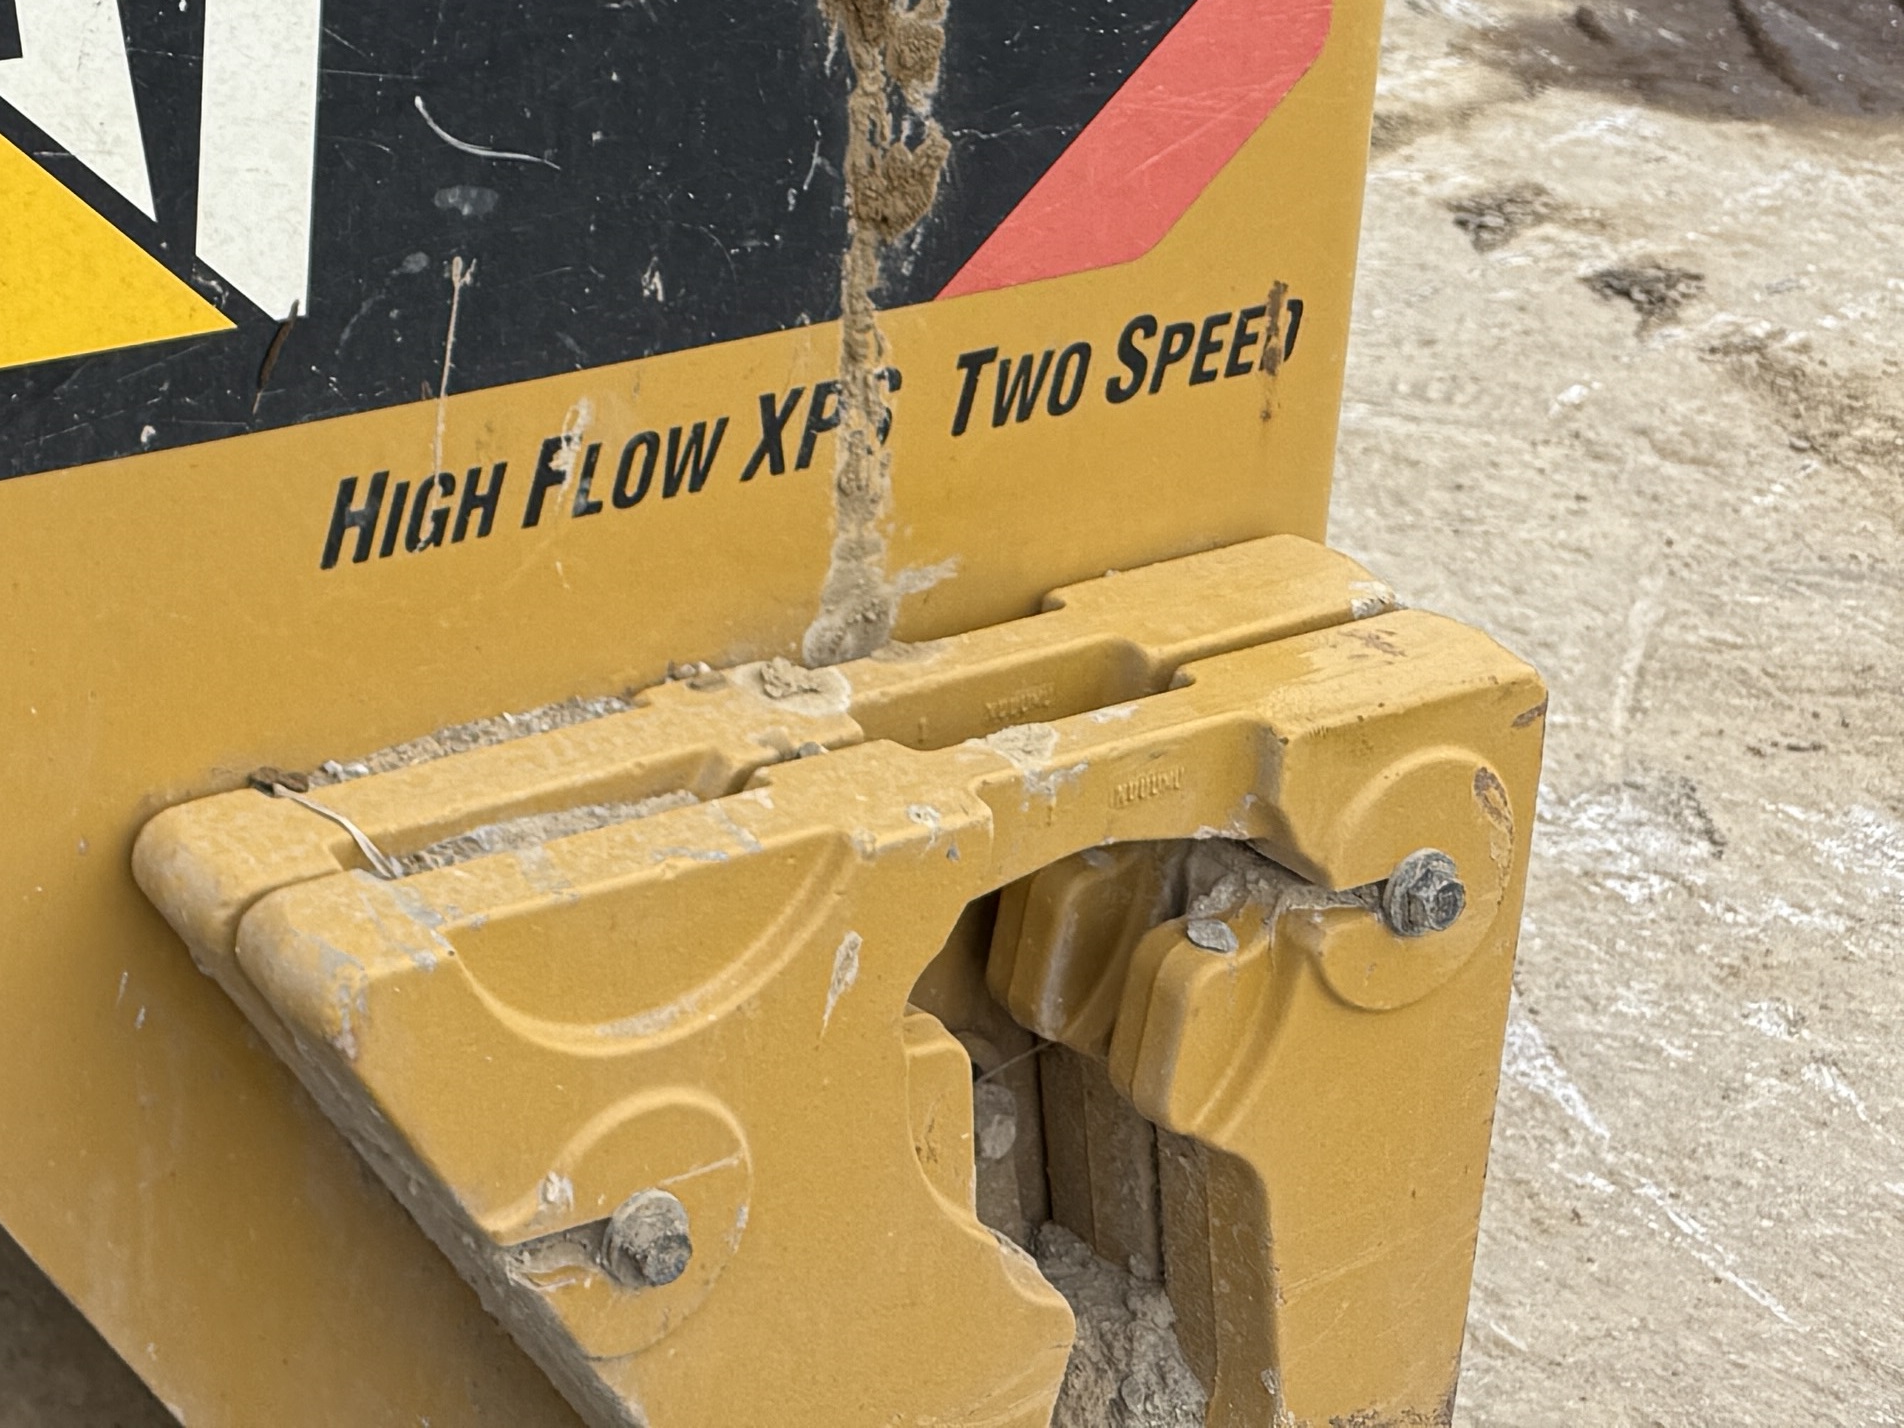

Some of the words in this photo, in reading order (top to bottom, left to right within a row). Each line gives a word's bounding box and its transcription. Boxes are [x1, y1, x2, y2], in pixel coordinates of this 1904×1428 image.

[319, 462, 508, 571] HIGH
[523, 416, 730, 530] FLOW
[949, 347, 1092, 437] TWO
[1106, 298, 1304, 406] SPEED
